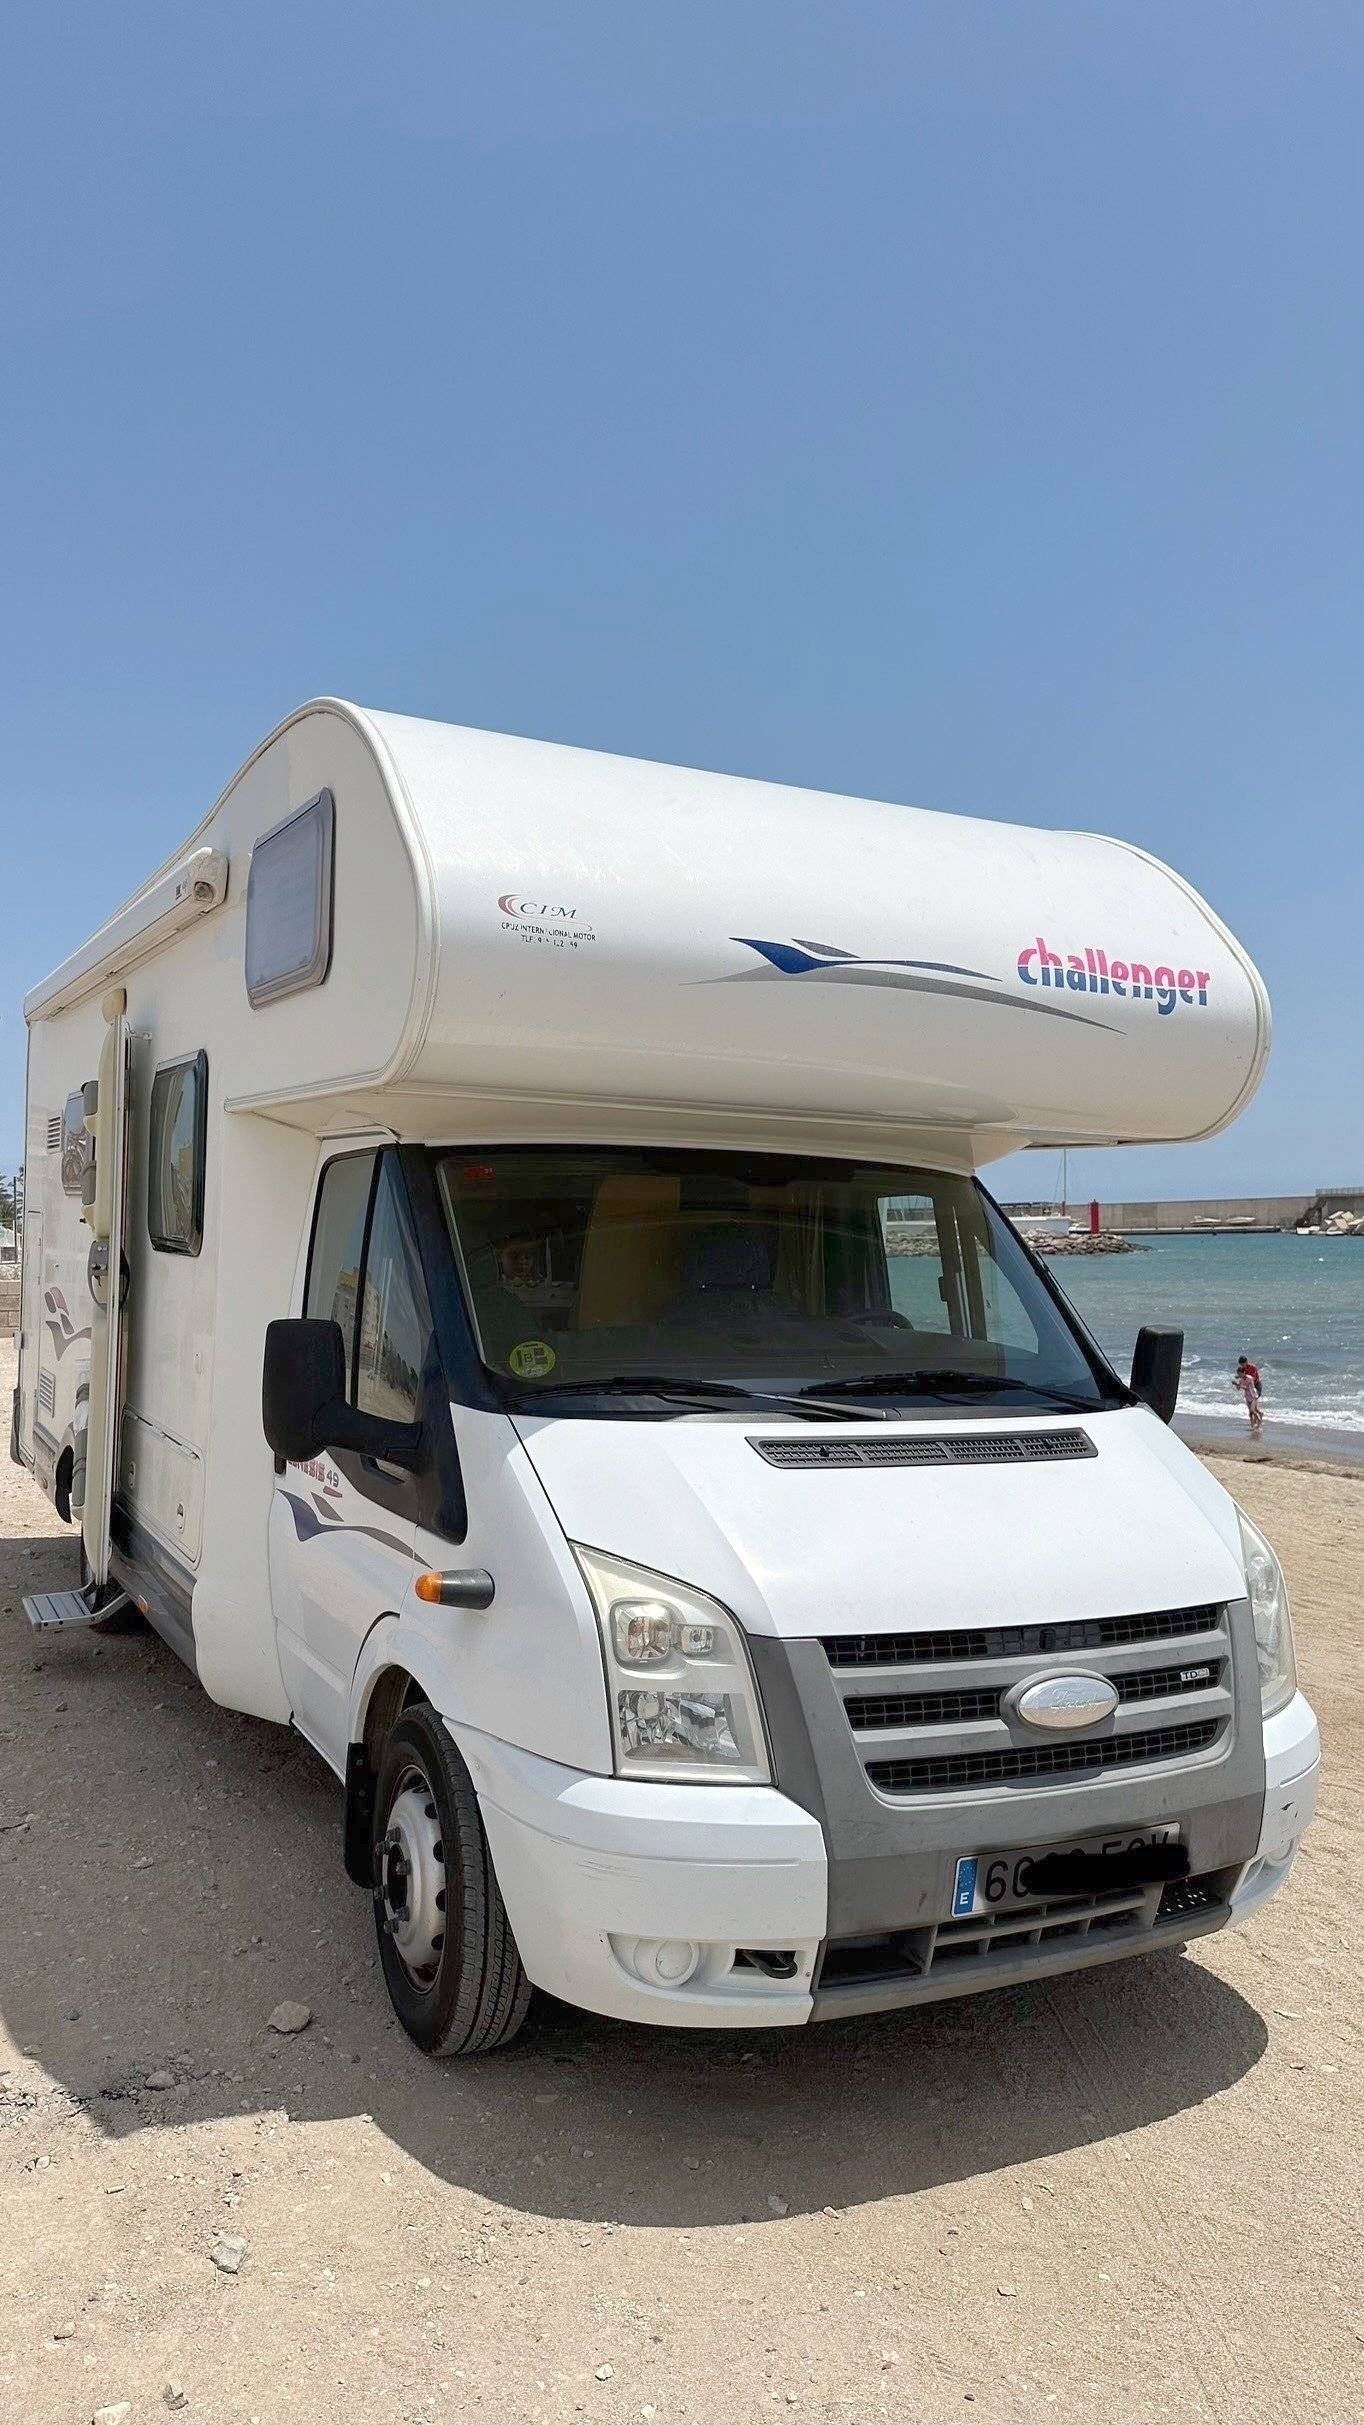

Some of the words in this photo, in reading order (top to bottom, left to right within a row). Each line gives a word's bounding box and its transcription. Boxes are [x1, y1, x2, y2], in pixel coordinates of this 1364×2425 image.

[520, 902, 577, 919] CIM
[573, 933, 596, 941] MOTOR
[1017, 937, 1211, 1015] challenger
[326, 1469, 339, 1487] 49
[959, 1891, 970, 1905] E
